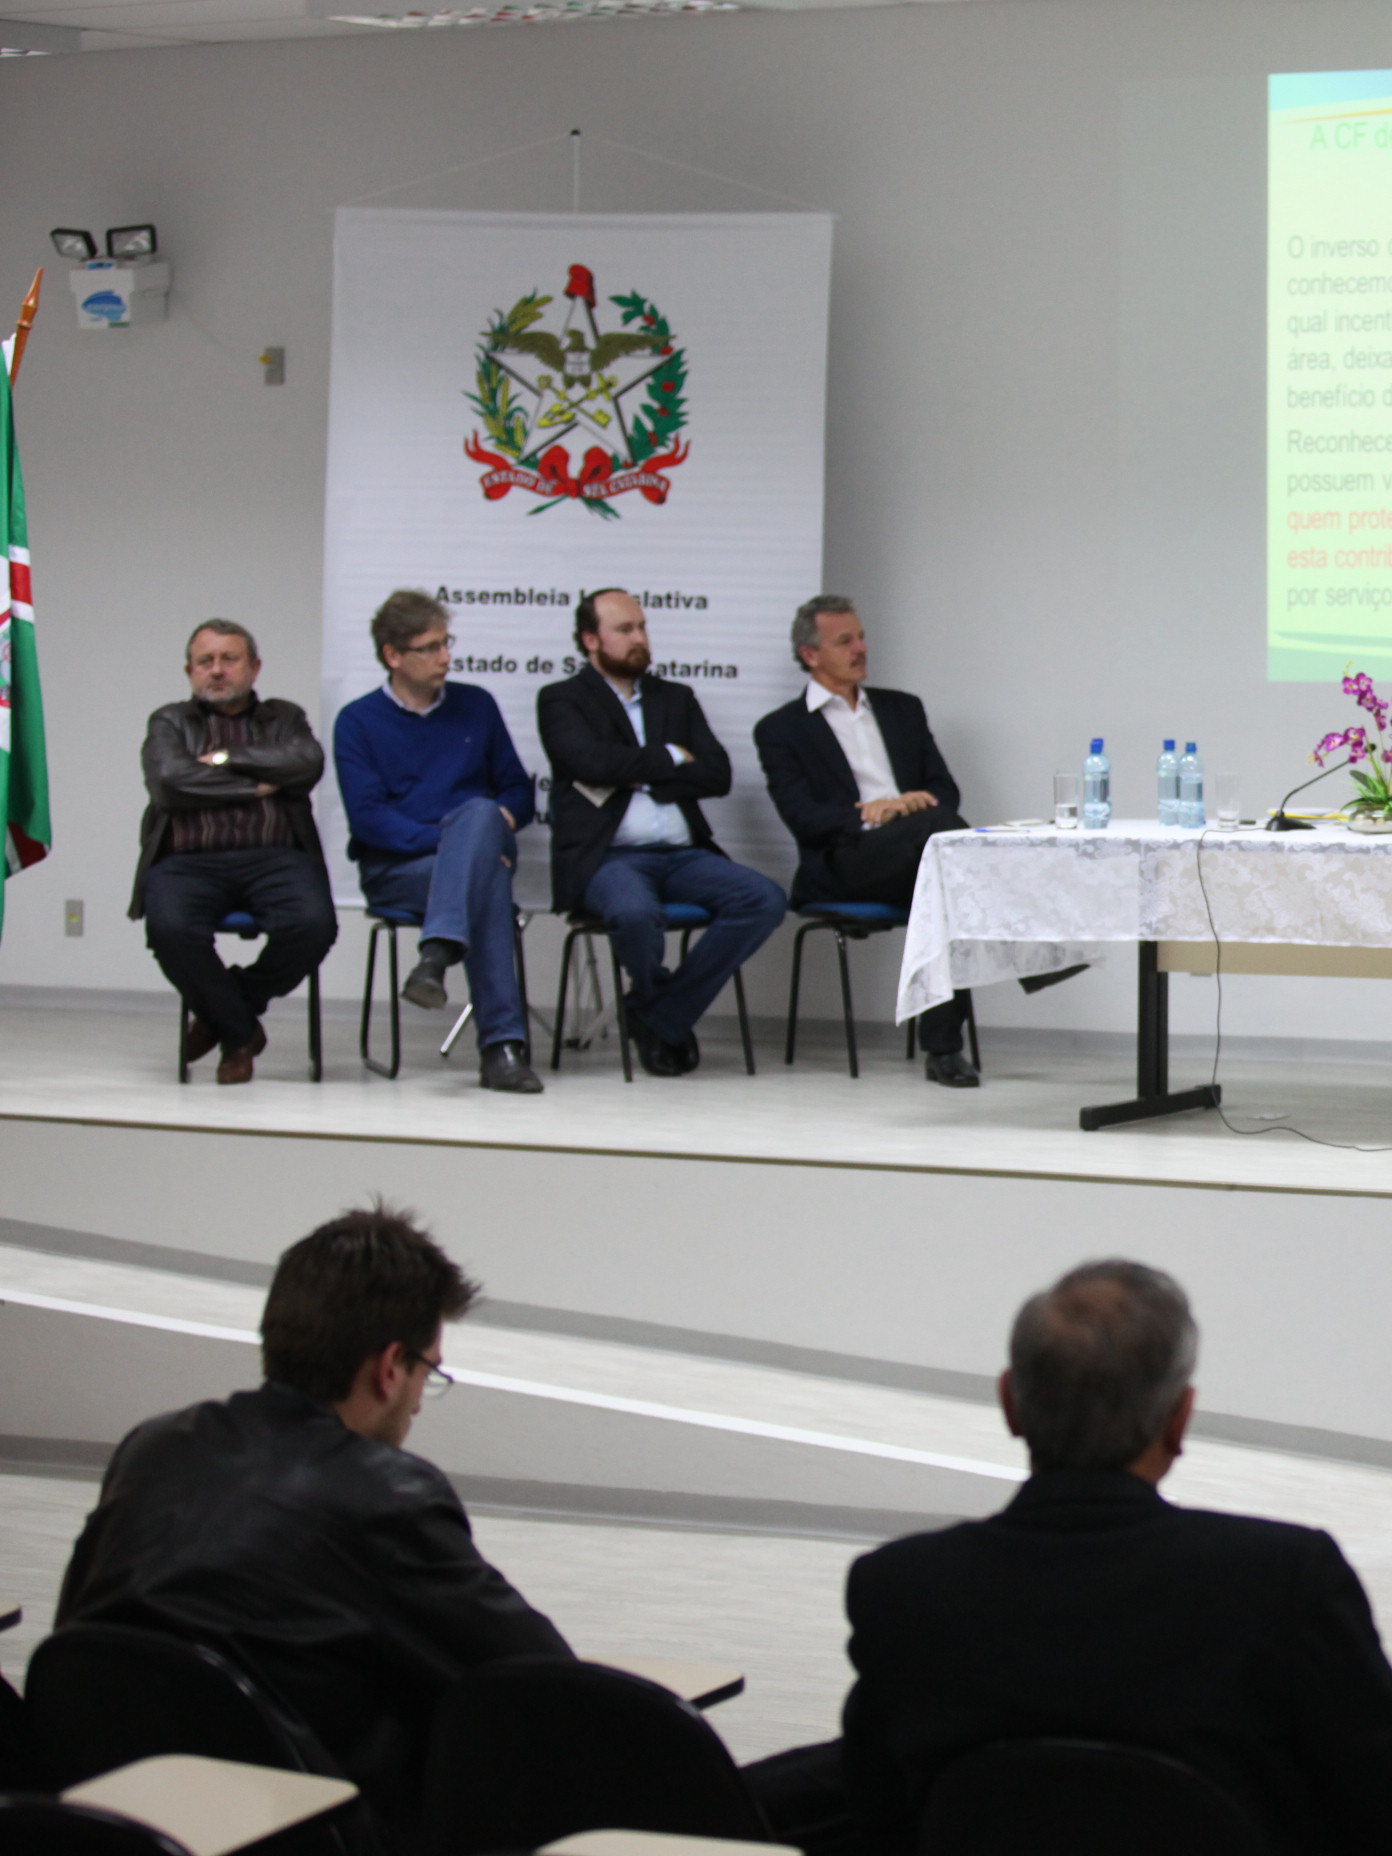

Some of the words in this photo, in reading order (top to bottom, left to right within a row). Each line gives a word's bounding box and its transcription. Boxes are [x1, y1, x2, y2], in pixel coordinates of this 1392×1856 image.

[1309, 122, 1329, 150] A
[1334, 118, 1370, 151] CF
[1286, 233, 1306, 260] O
[1310, 237, 1380, 259] inverso
[1286, 309, 1329, 339] qual
[1286, 472, 1376, 498] possuem
[1287, 511, 1341, 530] quem
[1286, 548, 1328, 569] esta
[436, 585, 570, 606] Assembleia
[580, 588, 709, 611] slativa
[1286, 586, 1320, 612] por
[448, 654, 518, 673] stado
[526, 655, 554, 674] de
[650, 658, 739, 679] atarina
